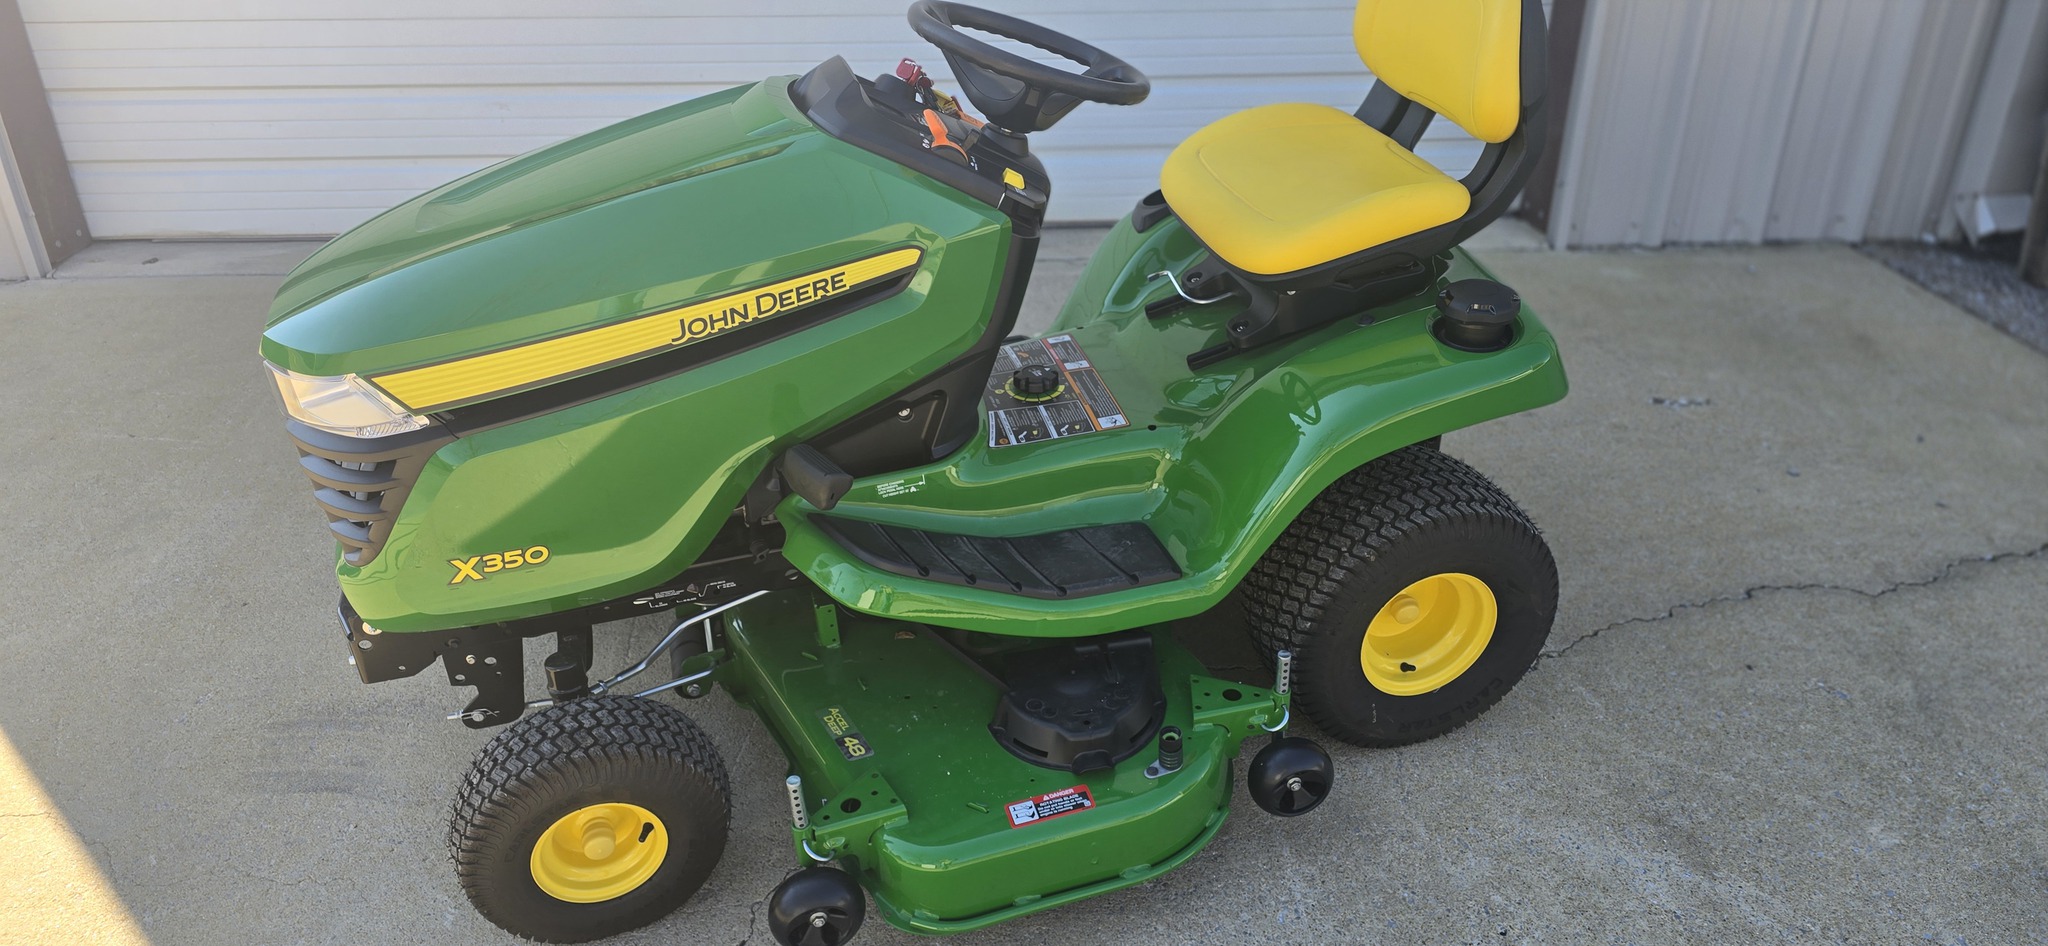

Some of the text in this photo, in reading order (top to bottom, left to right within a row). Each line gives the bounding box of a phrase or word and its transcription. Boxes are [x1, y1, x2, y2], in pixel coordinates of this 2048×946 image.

[671, 271, 848, 344] JOHN DEERE
[448, 545, 550, 585] X350
[823, 715, 843, 735] DEEP
[828, 708, 849, 731] ACCEL
[843, 737, 866, 757] 48
[1048, 788, 1075, 799] DANGER
